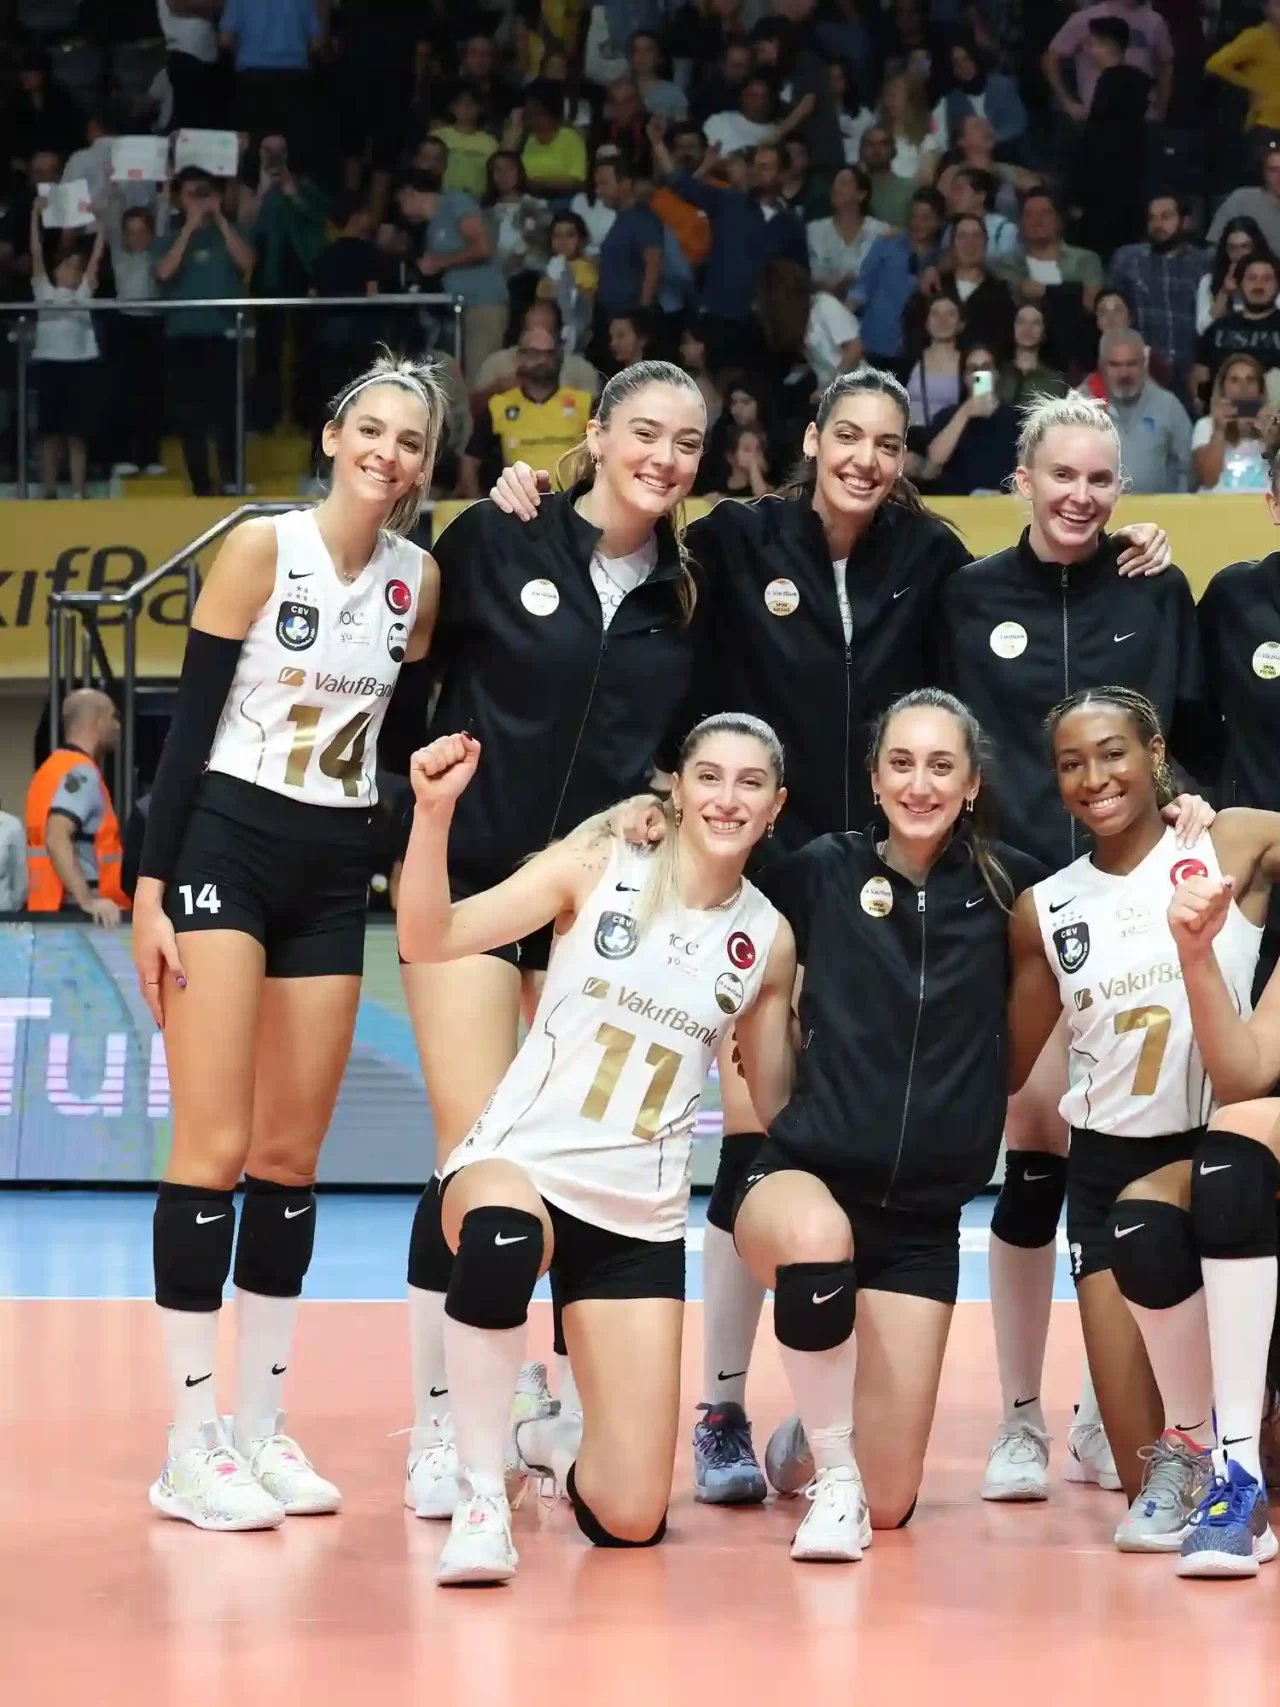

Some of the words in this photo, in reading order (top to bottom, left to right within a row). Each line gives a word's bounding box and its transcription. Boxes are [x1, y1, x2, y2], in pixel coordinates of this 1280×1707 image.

[290, 605, 309, 616] CEV
[314, 672, 397, 699] VakıfBank
[283, 704, 375, 798] 14
[179, 883, 222, 915] 14
[1061, 927, 1078, 938] CEV
[1099, 962, 1185, 1000] VakıfBa
[616, 986, 718, 1048] VakıfBank
[1113, 1004, 1172, 1096] 7
[579, 1021, 684, 1142] 11
